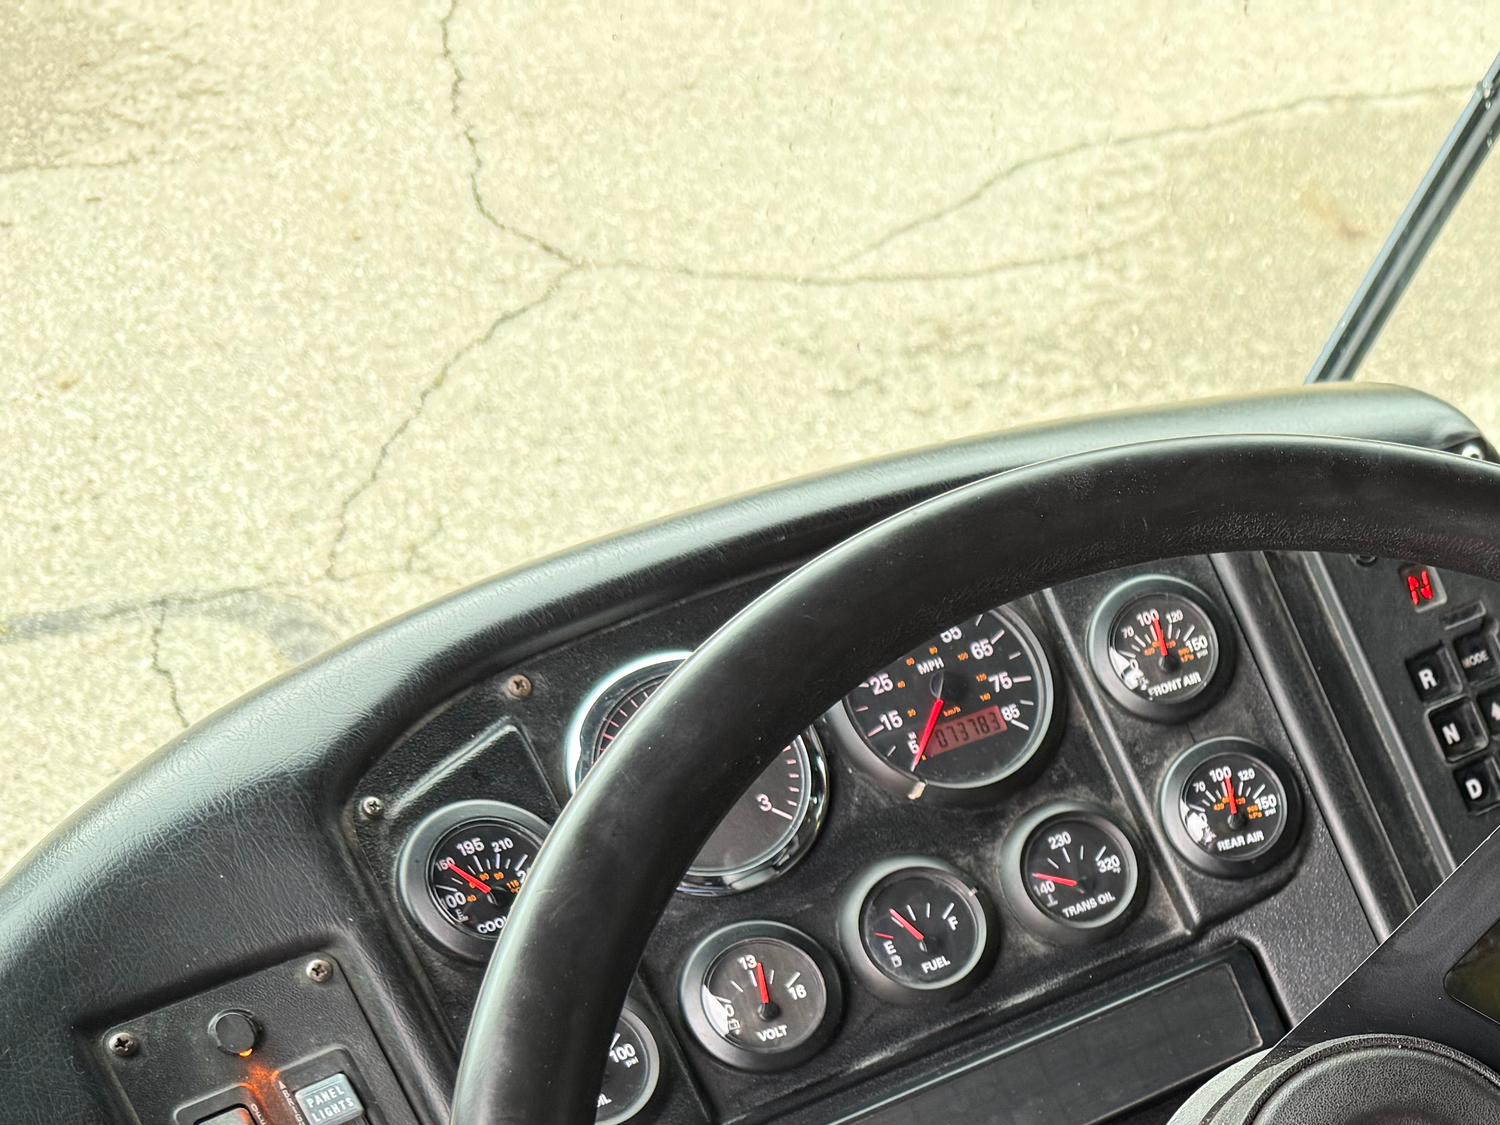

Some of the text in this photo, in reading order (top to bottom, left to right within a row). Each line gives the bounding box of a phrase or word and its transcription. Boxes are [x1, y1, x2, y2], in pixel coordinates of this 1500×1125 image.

[1136, 608, 1159, 626] 100
[1166, 609, 1184, 624] 120
[1121, 625, 1134, 639] 70
[970, 638, 994, 659] 65
[1185, 635, 1208, 653] 150
[916, 656, 945, 675] MPH
[1461, 650, 1489, 668] MODE
[869, 672, 894, 695] 25
[988, 671, 1012, 693] 75
[1147, 672, 1202, 697] FRONT AIR
[1418, 668, 1437, 690] R
[880, 709, 903, 731] 15
[1001, 703, 1021, 721] 85
[934, 711, 1000, 749] 073783
[1442, 723, 1461, 745] N
[1209, 766, 1232, 782] 100
[1238, 768, 1255, 781] 120
[1193, 781, 1206, 793] 70
[1465, 778, 1483, 800] D
[756, 793, 772, 811] 3
[1254, 794, 1277, 810] 150
[456, 837, 485, 856] 195
[491, 837, 513, 853] 210
[1048, 831, 1071, 850] 230
[1217, 830, 1264, 851] REAR AIR
[1097, 854, 1120, 873] 320
[1034, 880, 1055, 897] 140
[1062, 891, 1116, 918] TRANS OIL
[477, 916, 507, 934] COO
[947, 915, 958, 931] F
[883, 940, 897, 955] E
[737, 954, 757, 970] 13
[921, 955, 951, 974] FUEL
[756, 1024, 788, 1042] VOLT
[608, 1043, 636, 1063] 100
[305, 1085, 345, 1108] PANEL
[311, 1097, 354, 1122] LIGHTS
